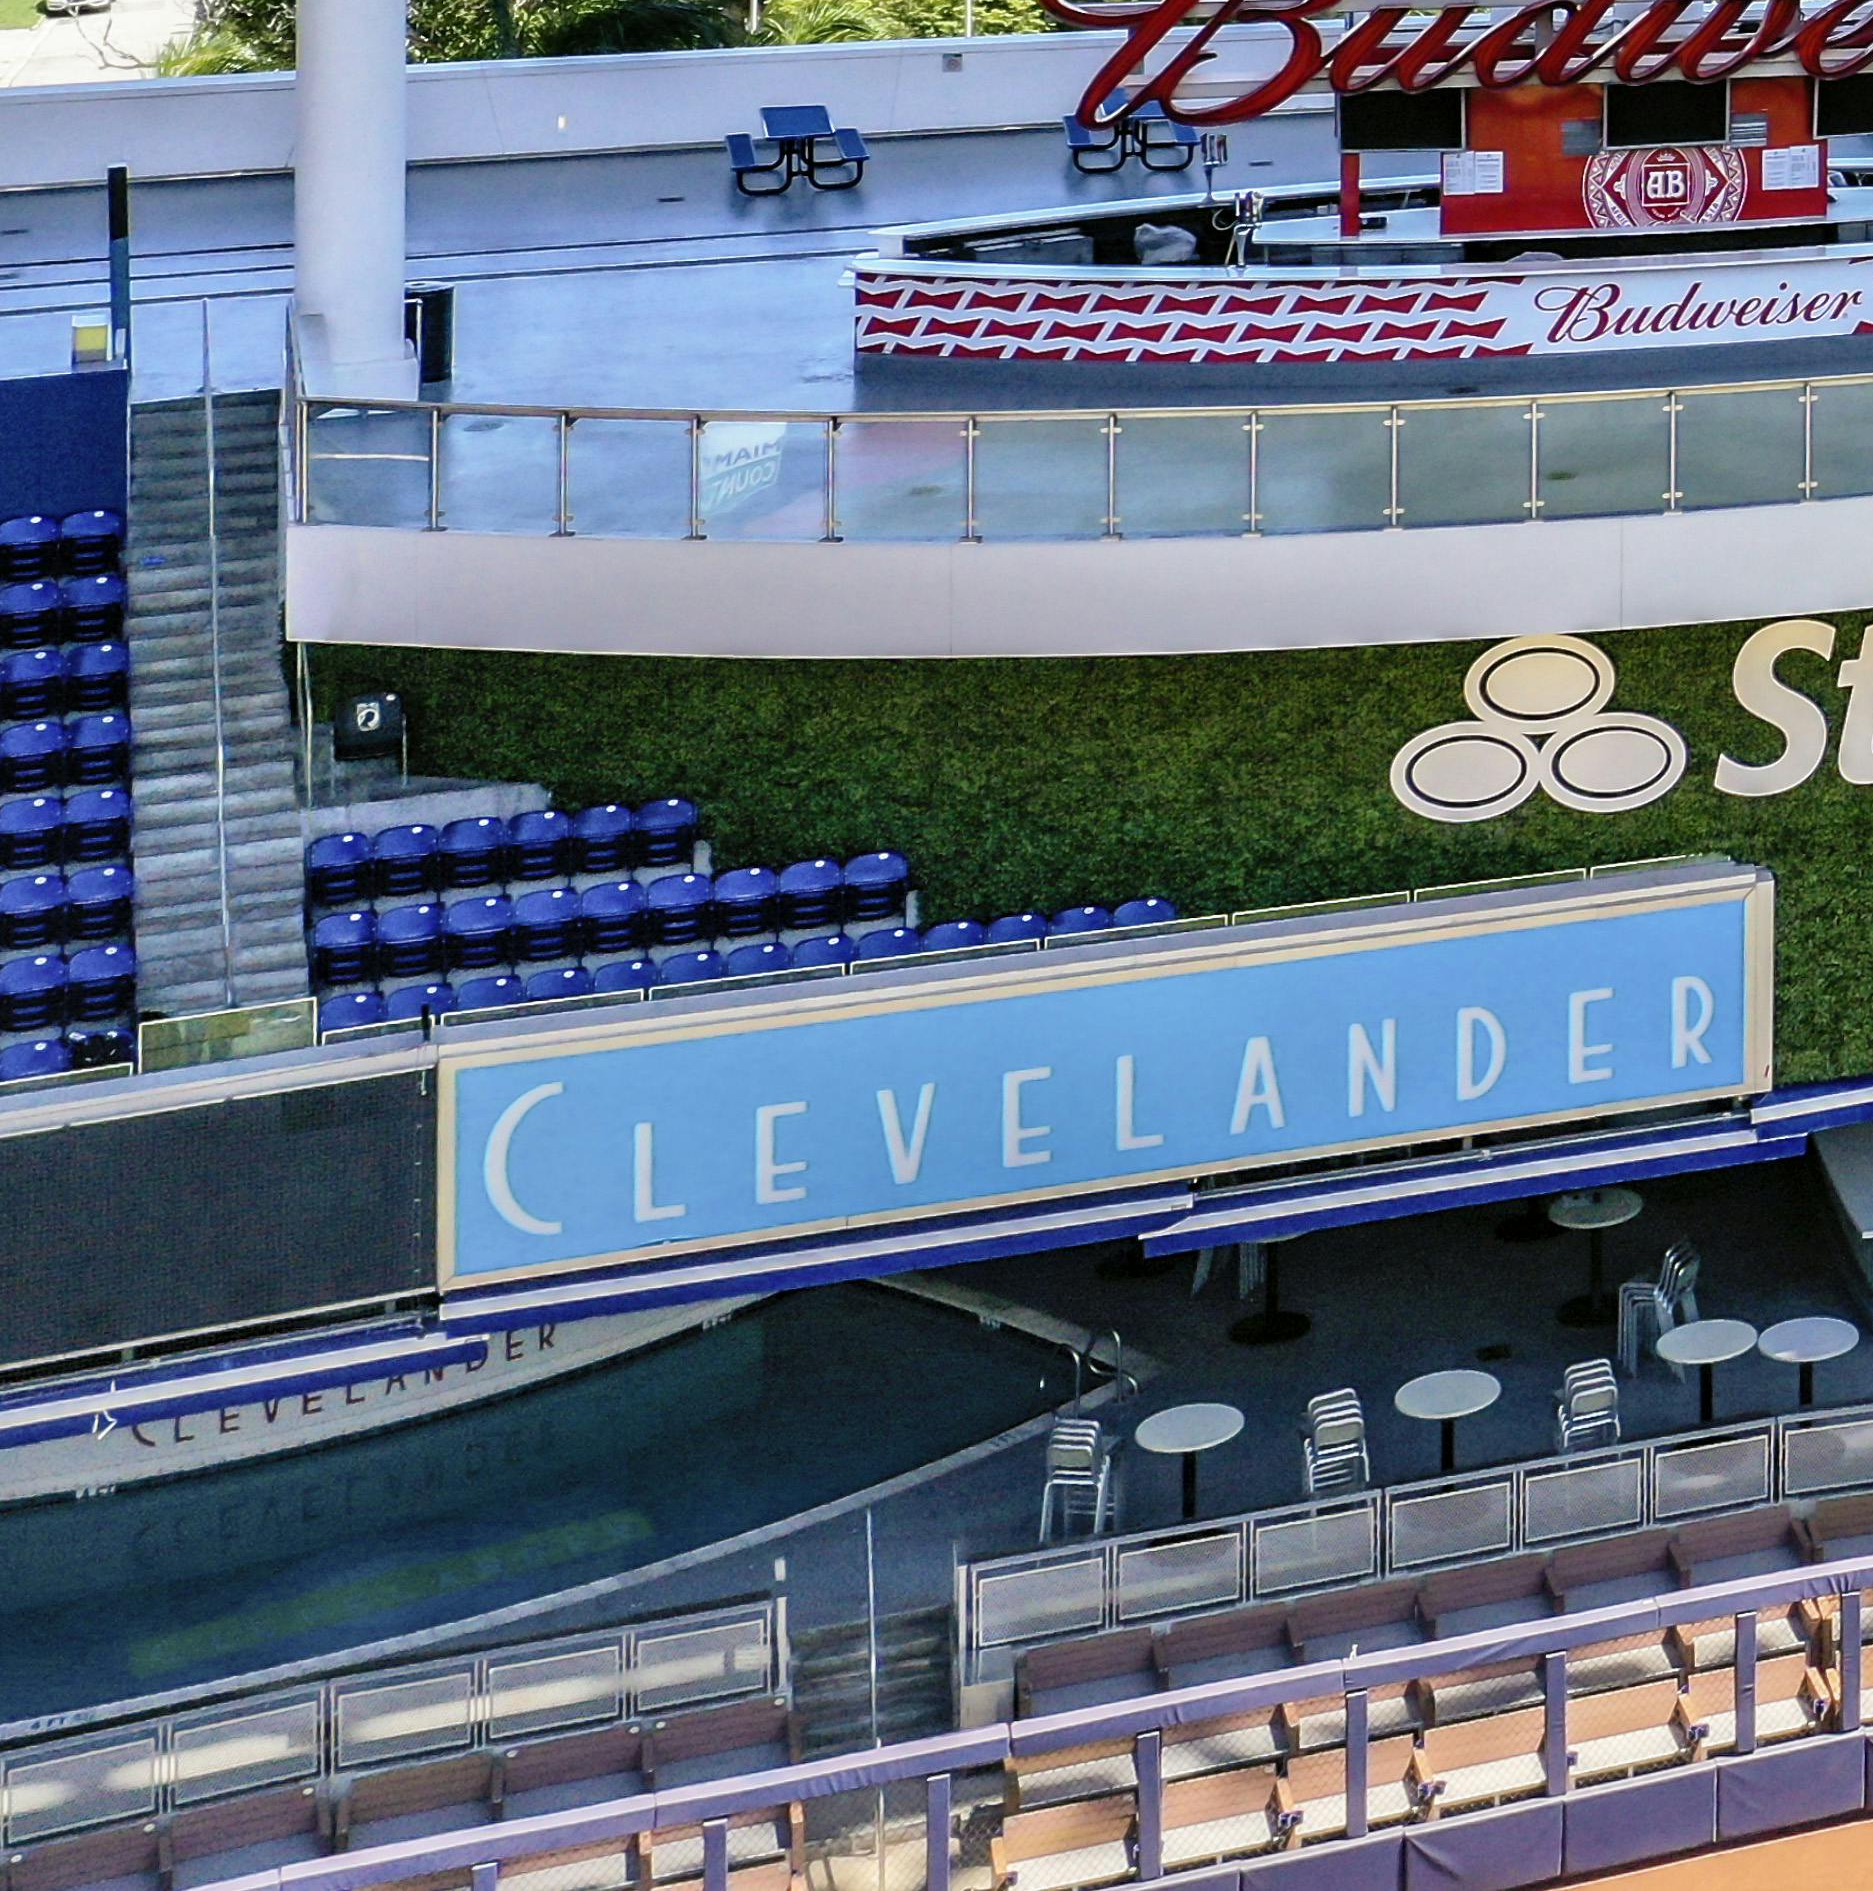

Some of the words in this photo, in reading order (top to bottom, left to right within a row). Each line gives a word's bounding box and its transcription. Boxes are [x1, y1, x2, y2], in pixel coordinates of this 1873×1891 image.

[1646, 170, 1685, 199] AB
[1534, 281, 1863, 344] Budweiser
[484, 975, 1717, 1235] CLEVELANDER
